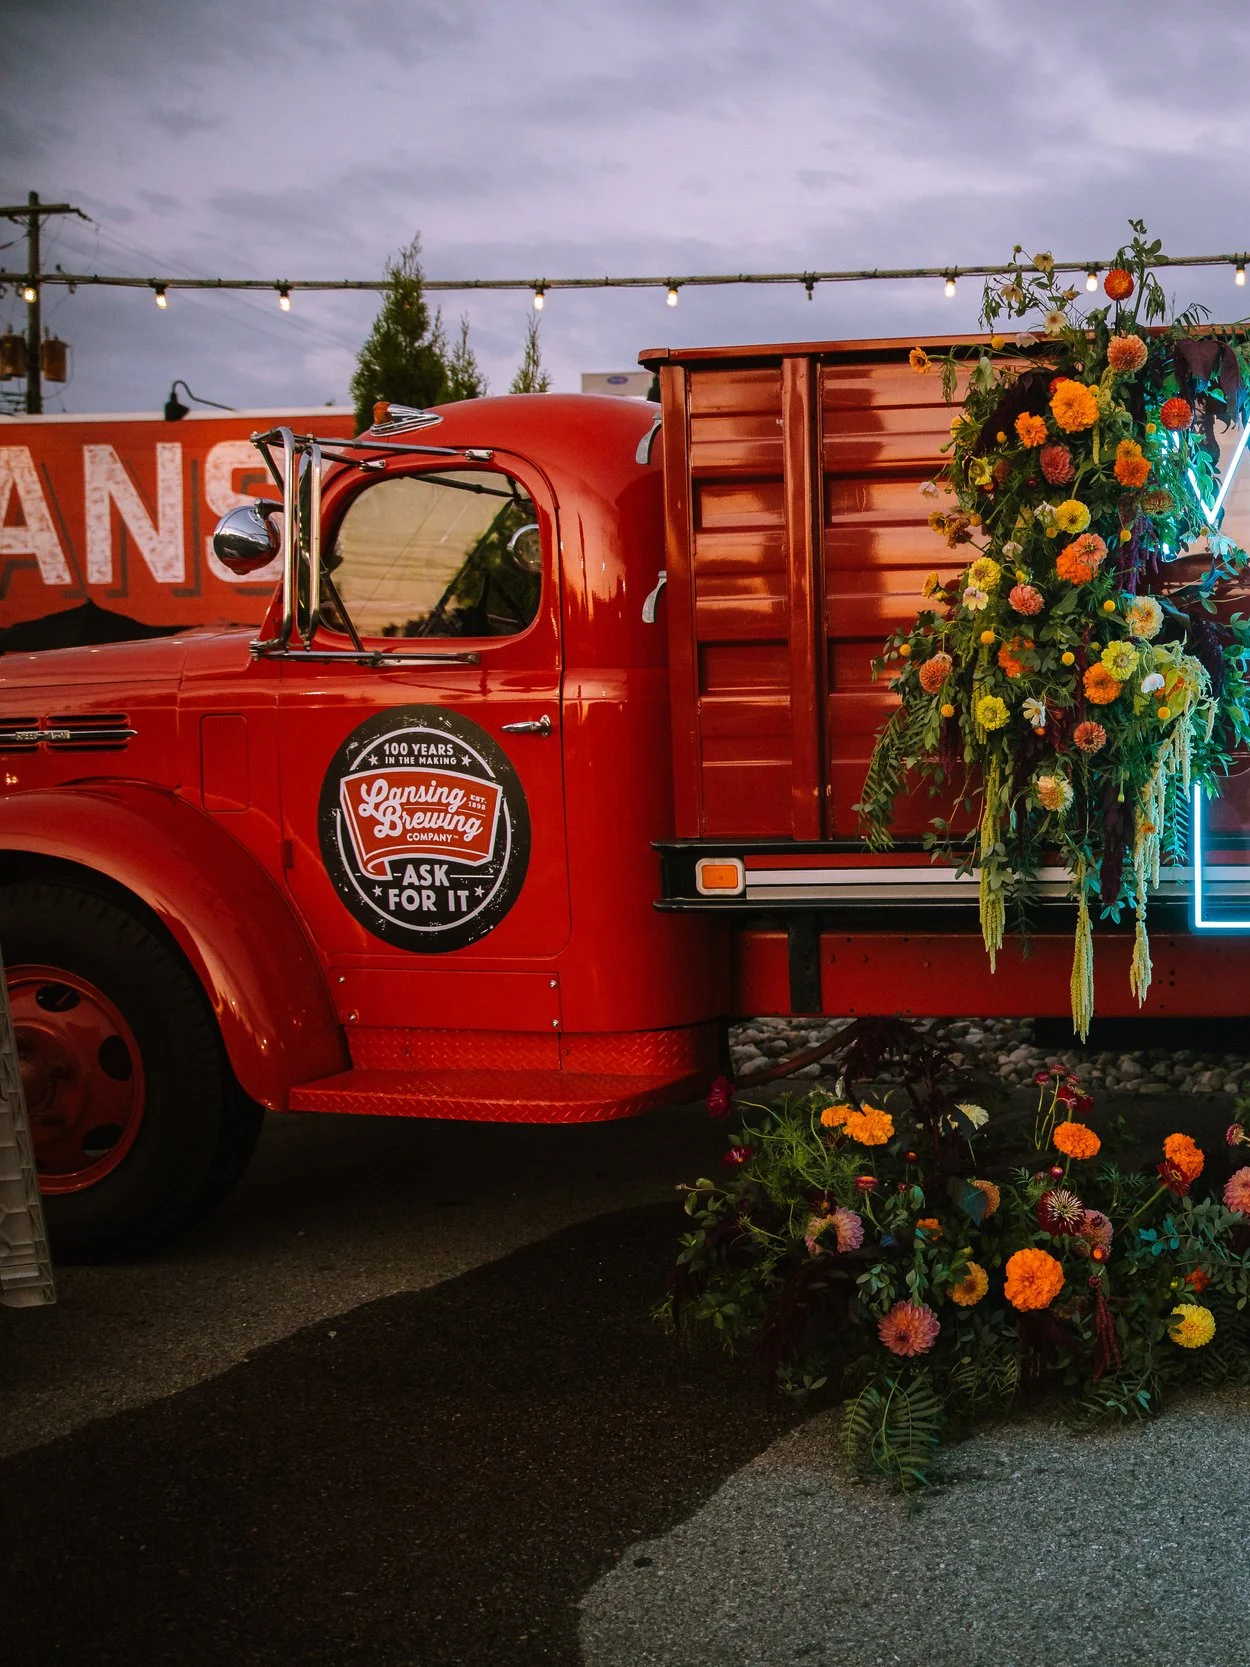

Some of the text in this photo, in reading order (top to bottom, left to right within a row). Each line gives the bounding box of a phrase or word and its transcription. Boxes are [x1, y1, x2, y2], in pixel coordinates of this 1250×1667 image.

[383, 742, 454, 756] 100 YEARS
[385, 756, 457, 765] IN THE MAKING
[358, 778, 467, 820] Lansing
[468, 801, 486, 811] 1898
[373, 801, 483, 842] Brewing
[402, 863, 450, 887] ASK
[388, 888, 470, 912] FOR IT
